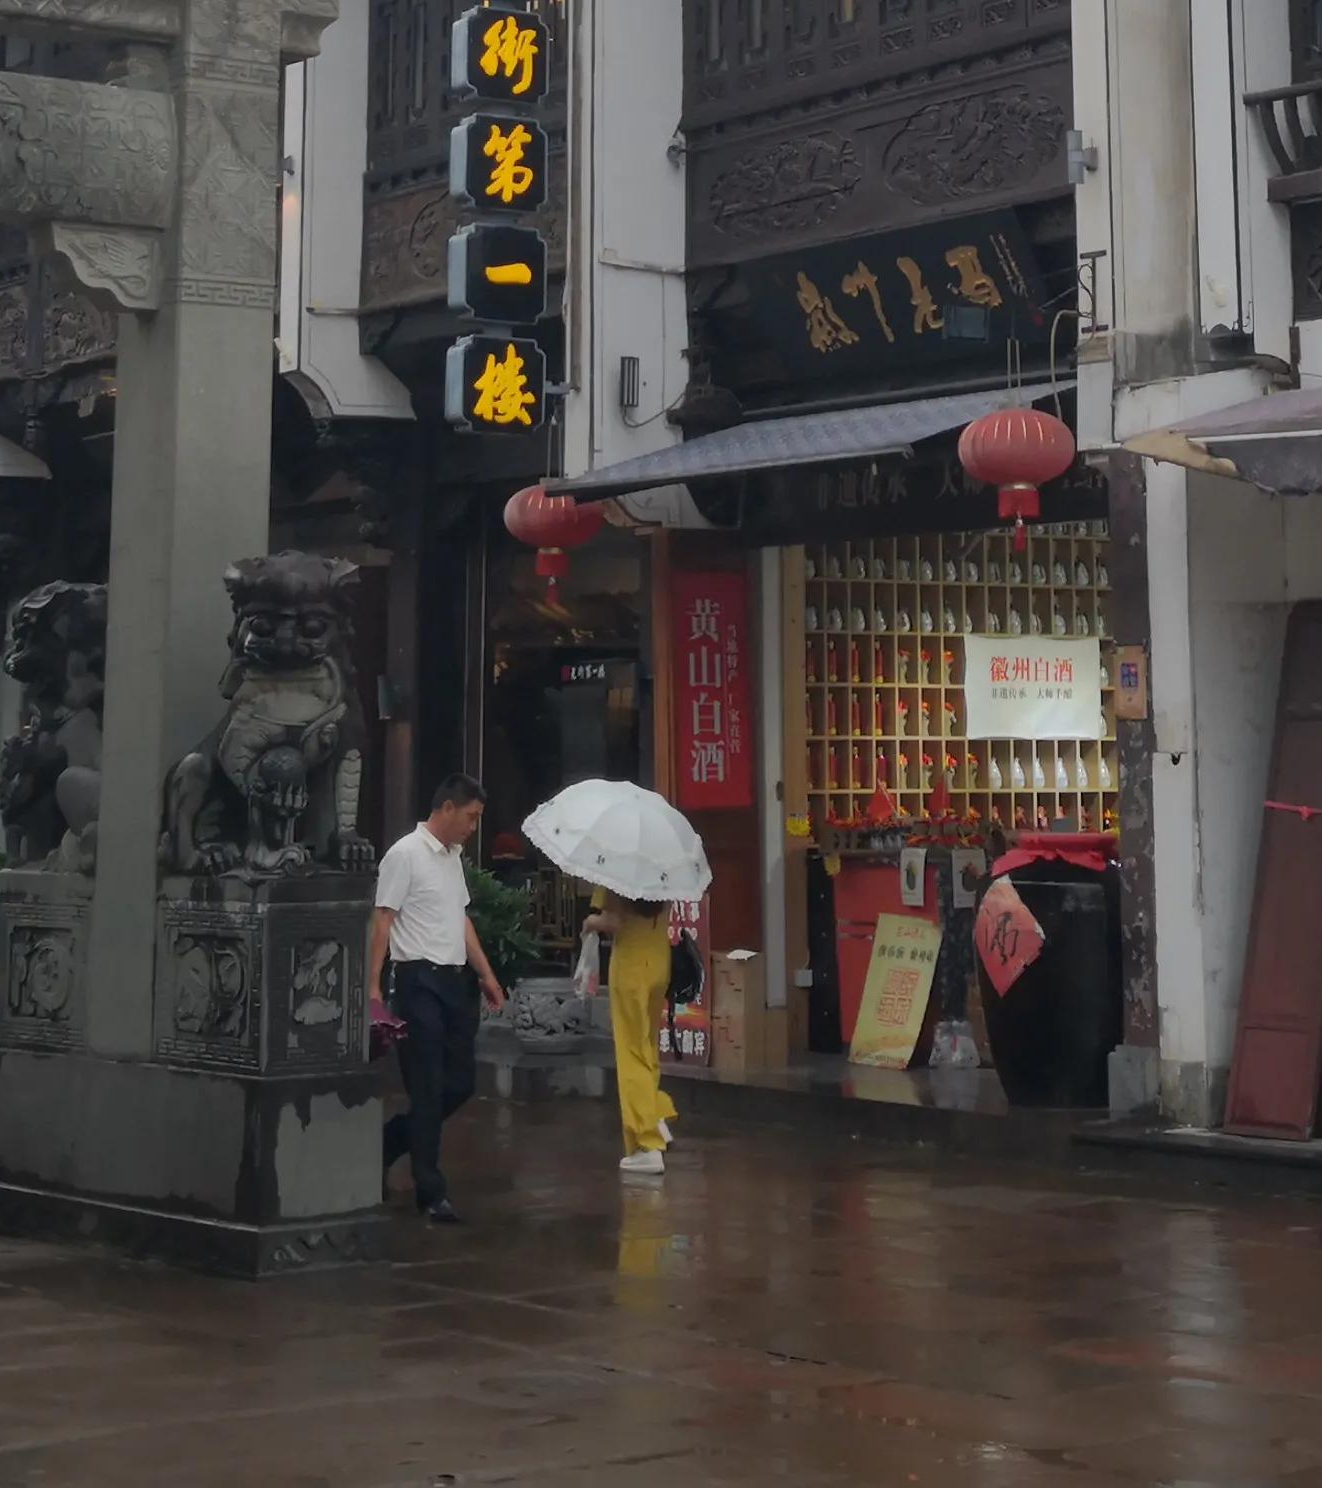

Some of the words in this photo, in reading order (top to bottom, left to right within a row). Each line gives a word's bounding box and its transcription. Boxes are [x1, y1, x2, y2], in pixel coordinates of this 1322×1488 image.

[686, 598, 725, 793] 黄山白酒
[990, 655, 1074, 683] 徽州白酒
